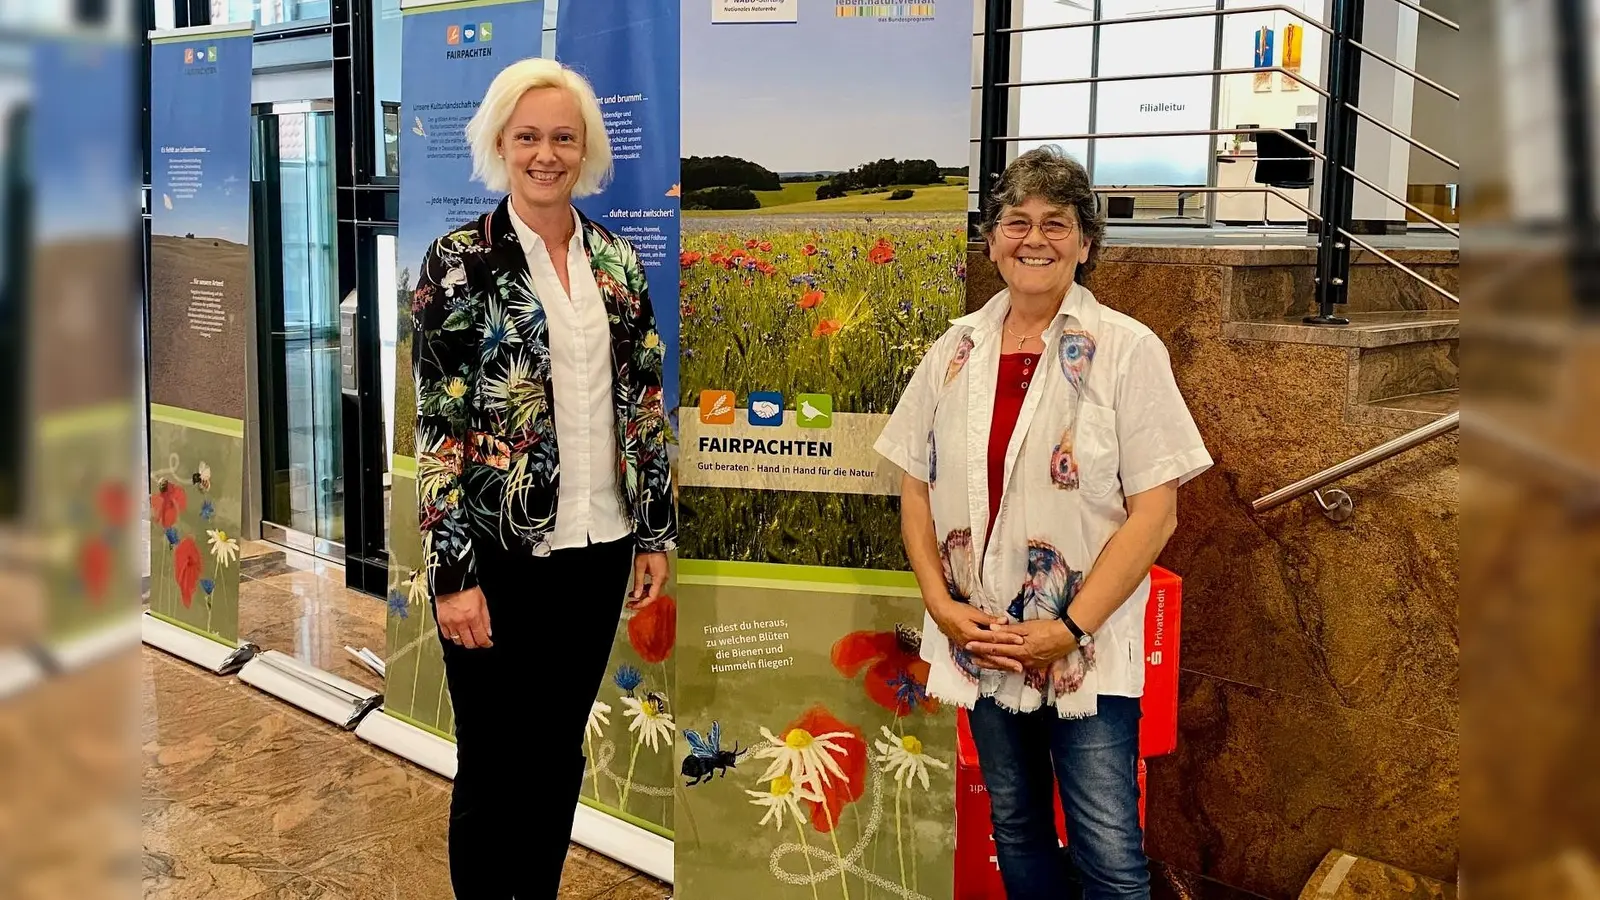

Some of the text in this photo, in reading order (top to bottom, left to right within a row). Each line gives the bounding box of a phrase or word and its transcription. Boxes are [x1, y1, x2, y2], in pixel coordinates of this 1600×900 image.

[446, 47, 492, 60] FAIRPACHTEN
[430, 100, 472, 110] Kulturlandschaft
[604, 94, 616, 104] und
[617, 93, 642, 103] brummt
[431, 197, 442, 205] jede
[443, 197, 459, 206] Menge
[460, 197, 473, 205] Platz
[474, 196, 482, 205] für
[609, 208, 629, 218] duftet
[629, 208, 642, 218] und
[643, 208, 675, 218] zwitschert!
[699, 437, 832, 457] FAIRPACHTEN
[697, 461, 713, 471] Gut
[715, 463, 749, 472] beraten
[757, 464, 780, 474] Hand
[782, 465, 790, 474] in
[792, 465, 816, 475] Hand
[818, 466, 832, 476] für
[833, 467, 847, 477] die
[849, 468, 875, 478] Natur
[1154, 588, 1166, 647] Privatkredit
[703, 619, 788, 635] Findest du heraus,
[706, 631, 789, 648] zu welchen Blüten
[715, 644, 783, 660] die Bienen und
[711, 656, 794, 673] Hummeln fliegen?
